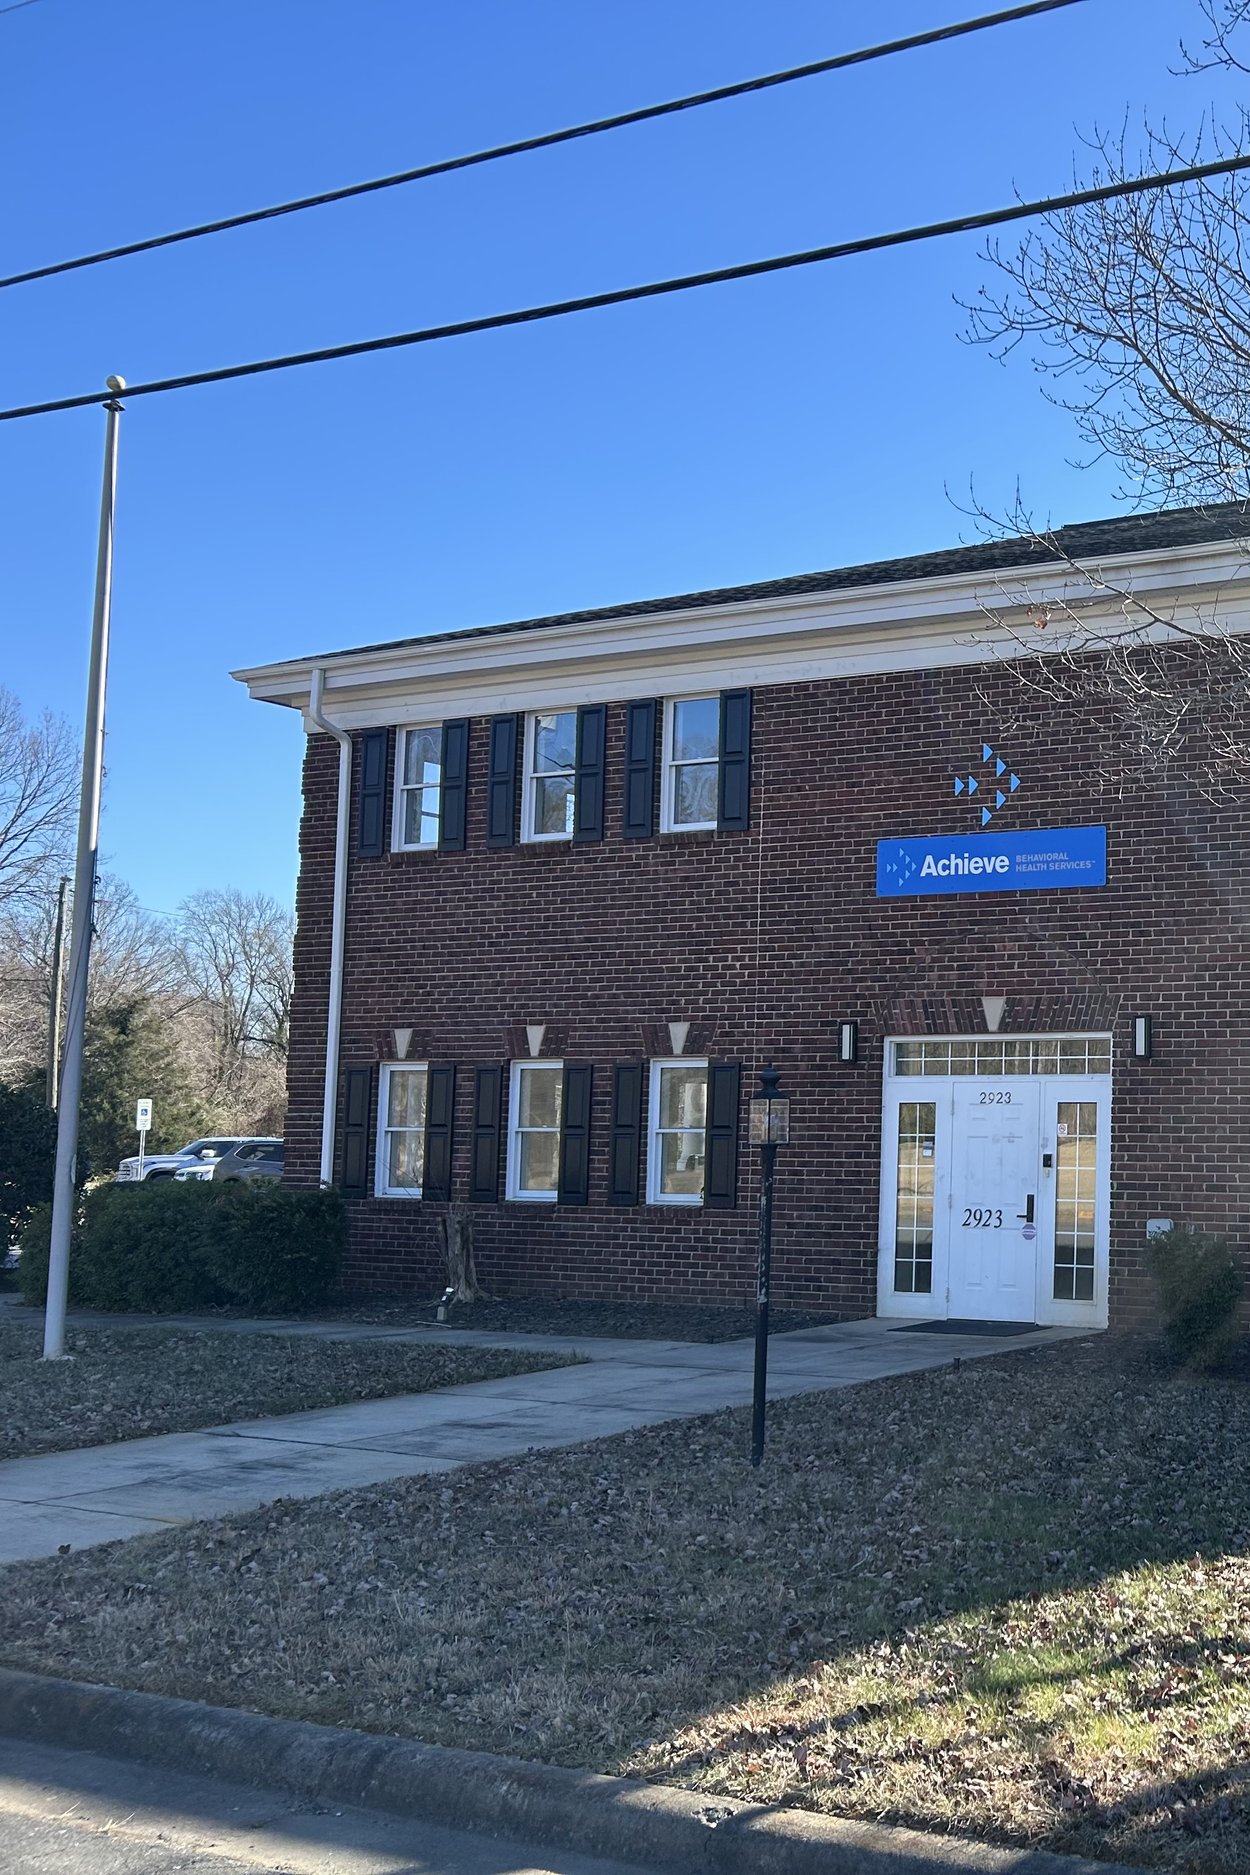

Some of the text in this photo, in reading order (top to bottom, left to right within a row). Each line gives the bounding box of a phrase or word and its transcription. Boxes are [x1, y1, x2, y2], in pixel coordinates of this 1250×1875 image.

[1016, 852, 1069, 862] BEHAVIORAL
[920, 853, 1010, 877] Achieve
[1016, 862, 1048, 872] HEALTH
[980, 1092, 1011, 1104] 2923
[962, 1208, 1002, 1229] 2923
